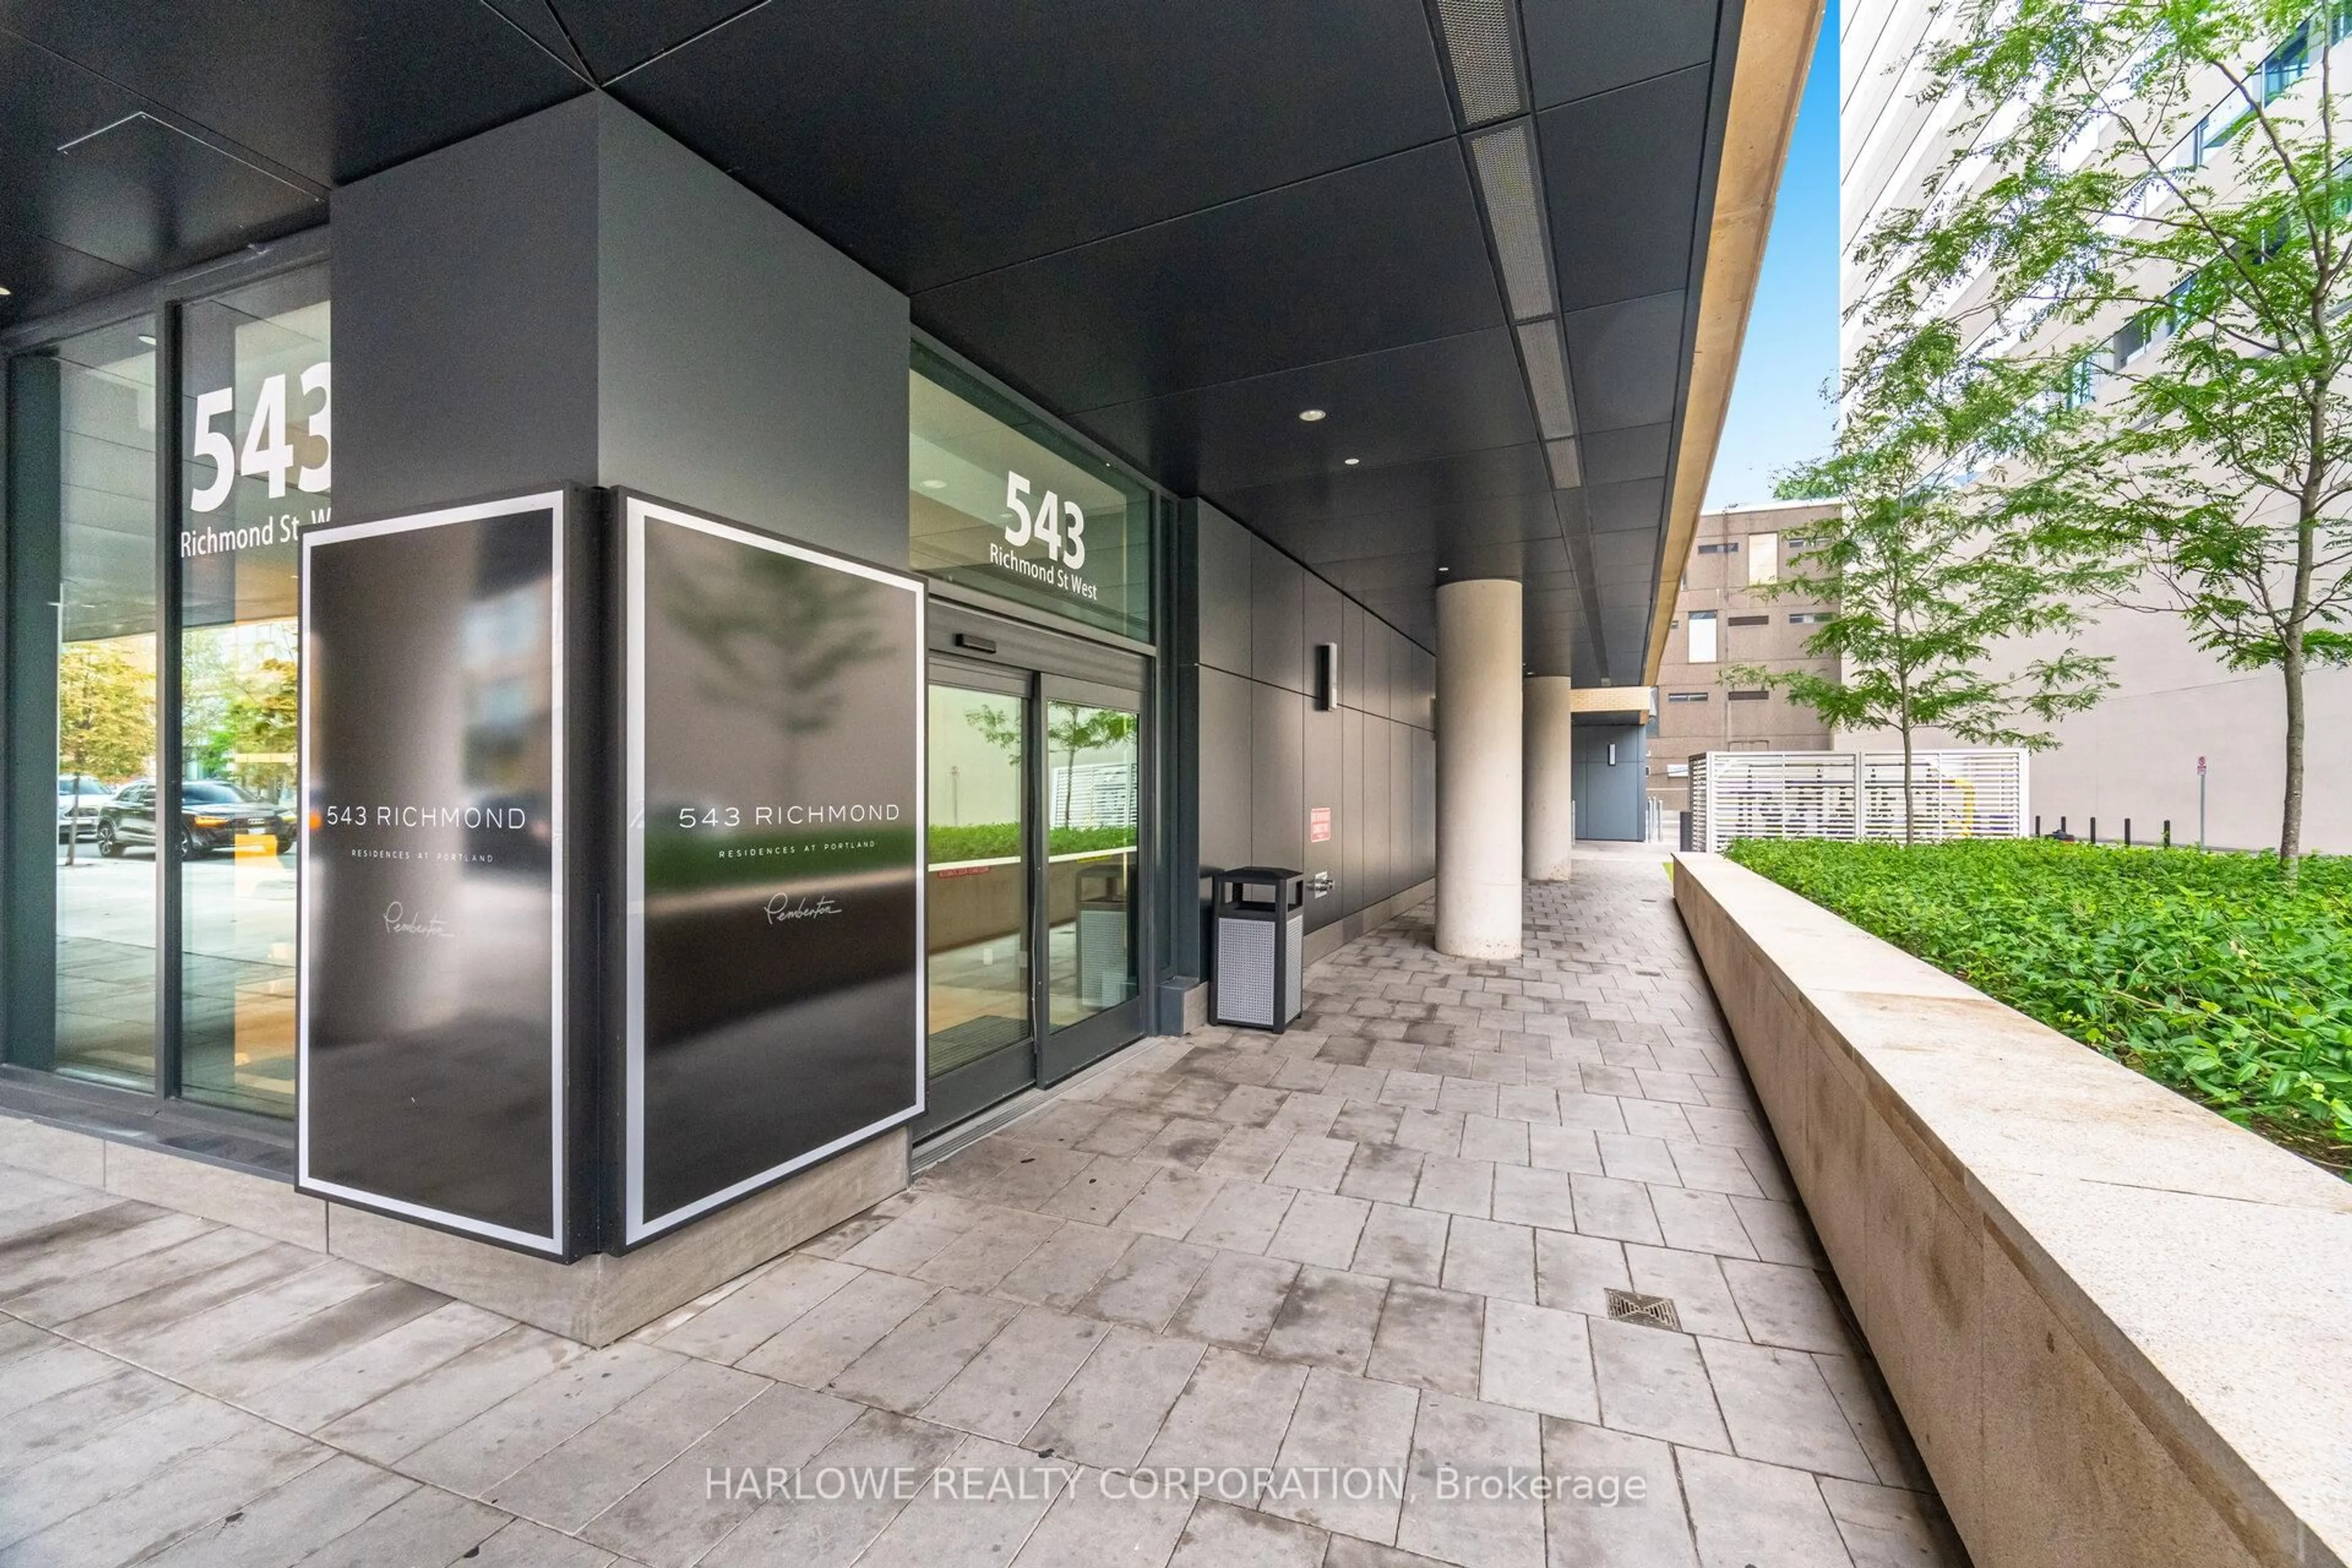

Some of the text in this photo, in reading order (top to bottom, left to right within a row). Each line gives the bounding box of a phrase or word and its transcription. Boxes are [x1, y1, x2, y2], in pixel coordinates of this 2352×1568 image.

[190, 361, 331, 512] 543
[181, 516, 273, 558] Richmond
[281, 514, 300, 543] St
[1005, 470, 1085, 569] 543
[990, 543, 1097, 600] Richmond St West
[327, 806, 525, 829] 543 RICHMOND
[679, 804, 899, 828] 543 RICHMOND
[351, 849, 410, 859] RESIDENCES
[437, 854, 493, 863] PORTLAND
[719, 846, 795, 858] RESIDENCES
[824, 840, 875, 851] PORTLAND
[383, 901, 455, 938] Pemberton
[764, 892, 842, 925] Pemberton
